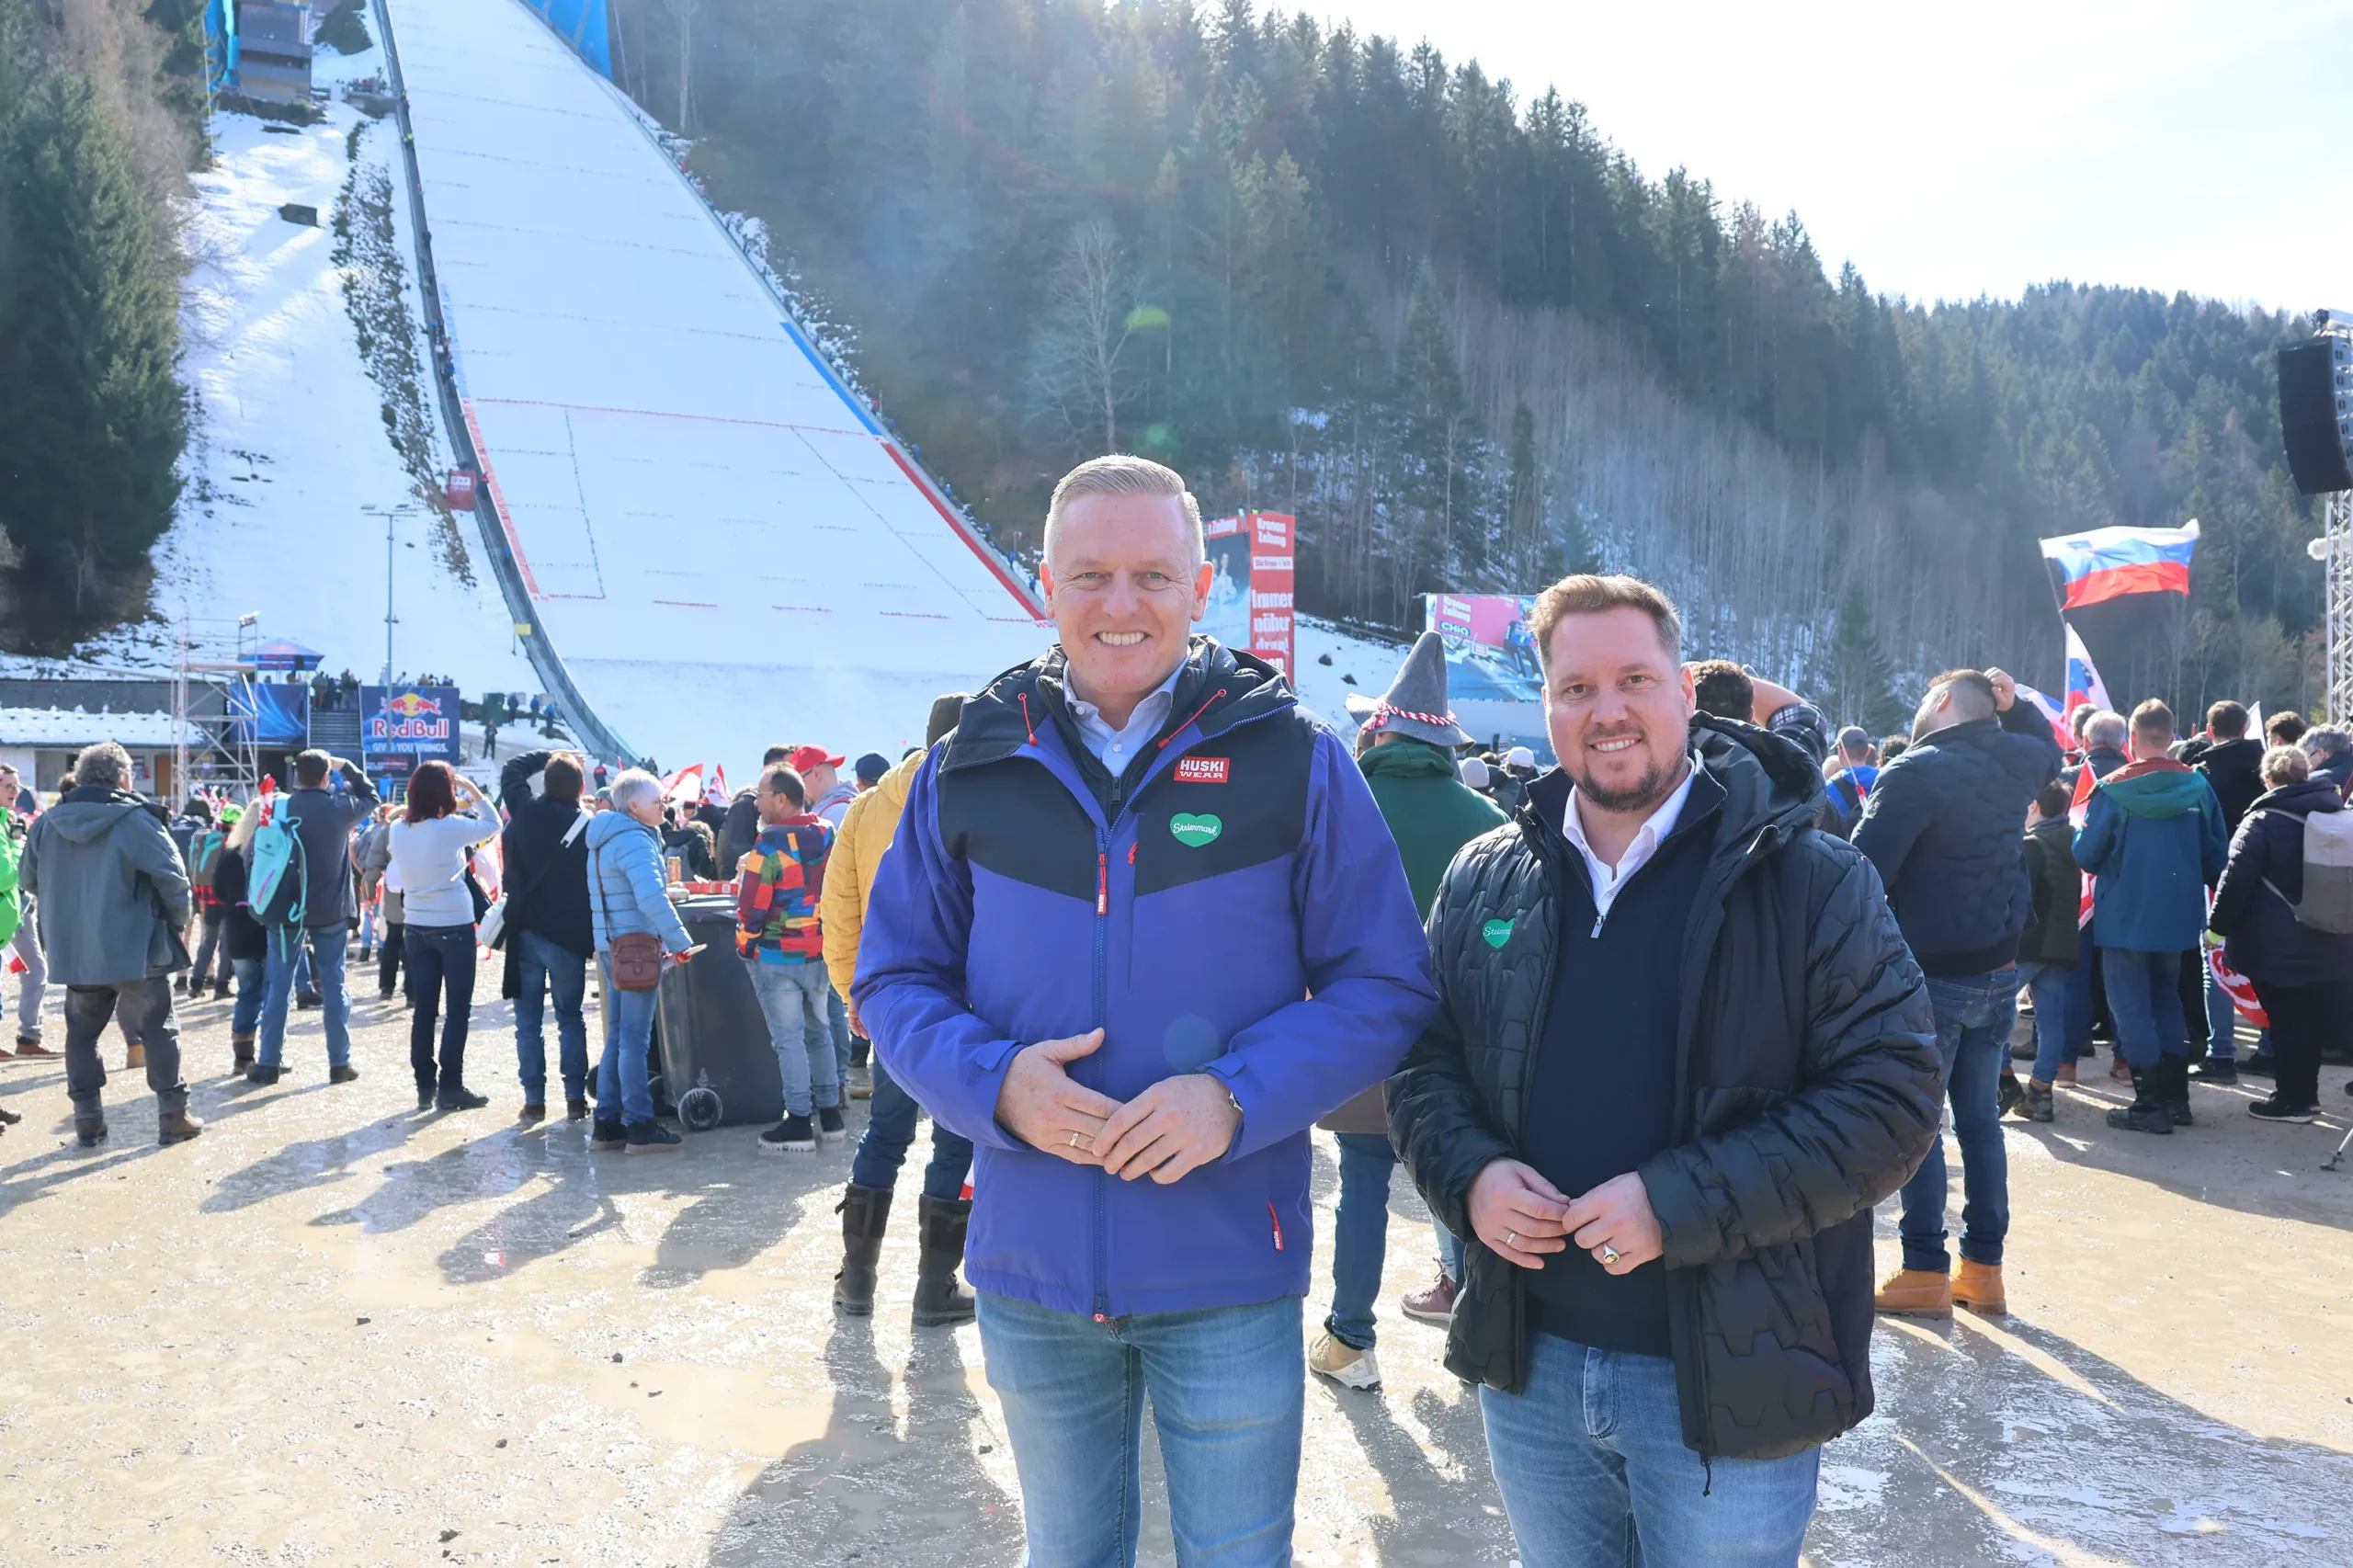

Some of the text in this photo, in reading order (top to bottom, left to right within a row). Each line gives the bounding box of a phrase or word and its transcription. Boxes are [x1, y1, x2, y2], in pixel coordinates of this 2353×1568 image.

[1256, 517, 1286, 533] Kronen
[1257, 530, 1286, 548] Zeitung
[1251, 589, 1293, 608] Immer
[1254, 612, 1290, 632] näher
[413, 718, 449, 738] Bull
[396, 743, 415, 752] YOU
[1179, 759, 1224, 772] HUSKI
[1179, 770, 1223, 778] WEAR
[1173, 823, 1218, 836] Steiermark
